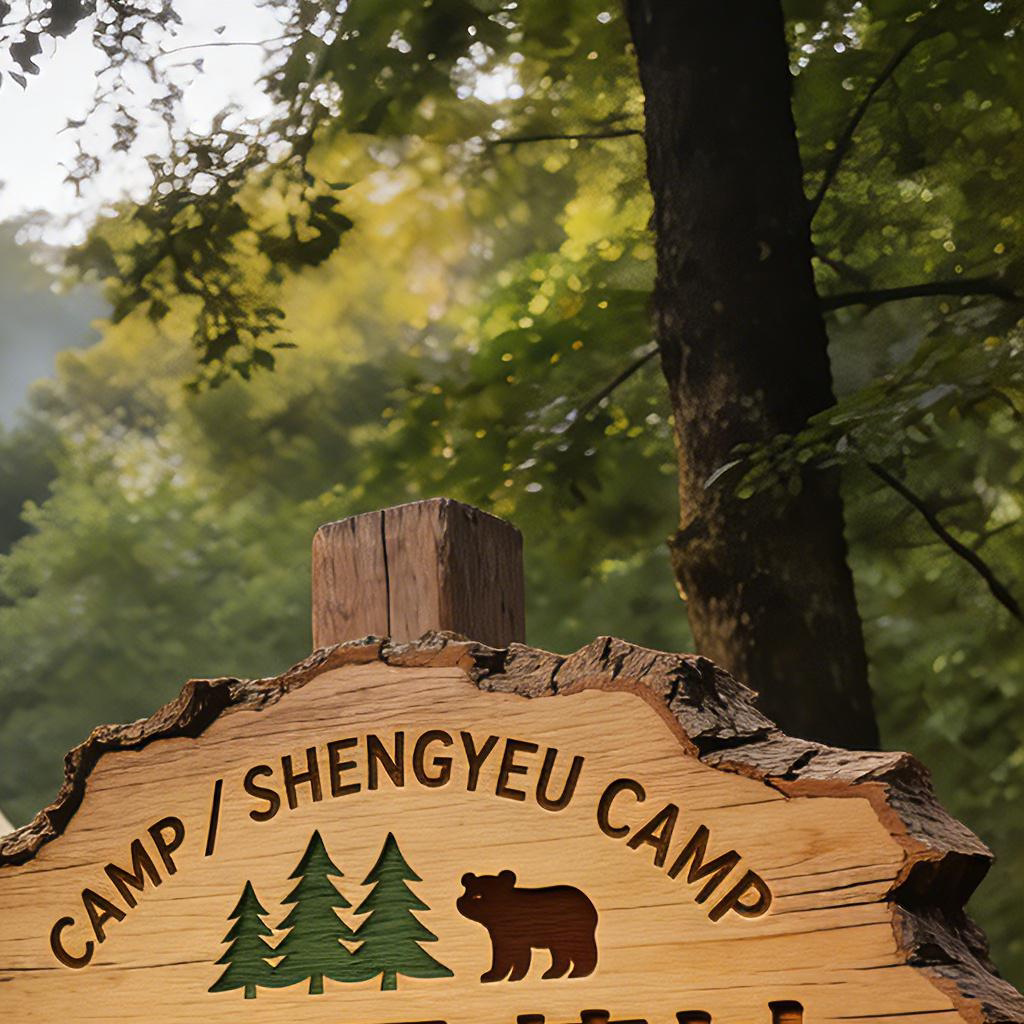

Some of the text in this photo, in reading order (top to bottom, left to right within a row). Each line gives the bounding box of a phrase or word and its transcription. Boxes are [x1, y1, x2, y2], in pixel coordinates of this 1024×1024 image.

[49, 815, 186, 968] CAMP
[242, 729, 585, 822] SHENGYEU
[596, 778, 773, 923] CAMP
